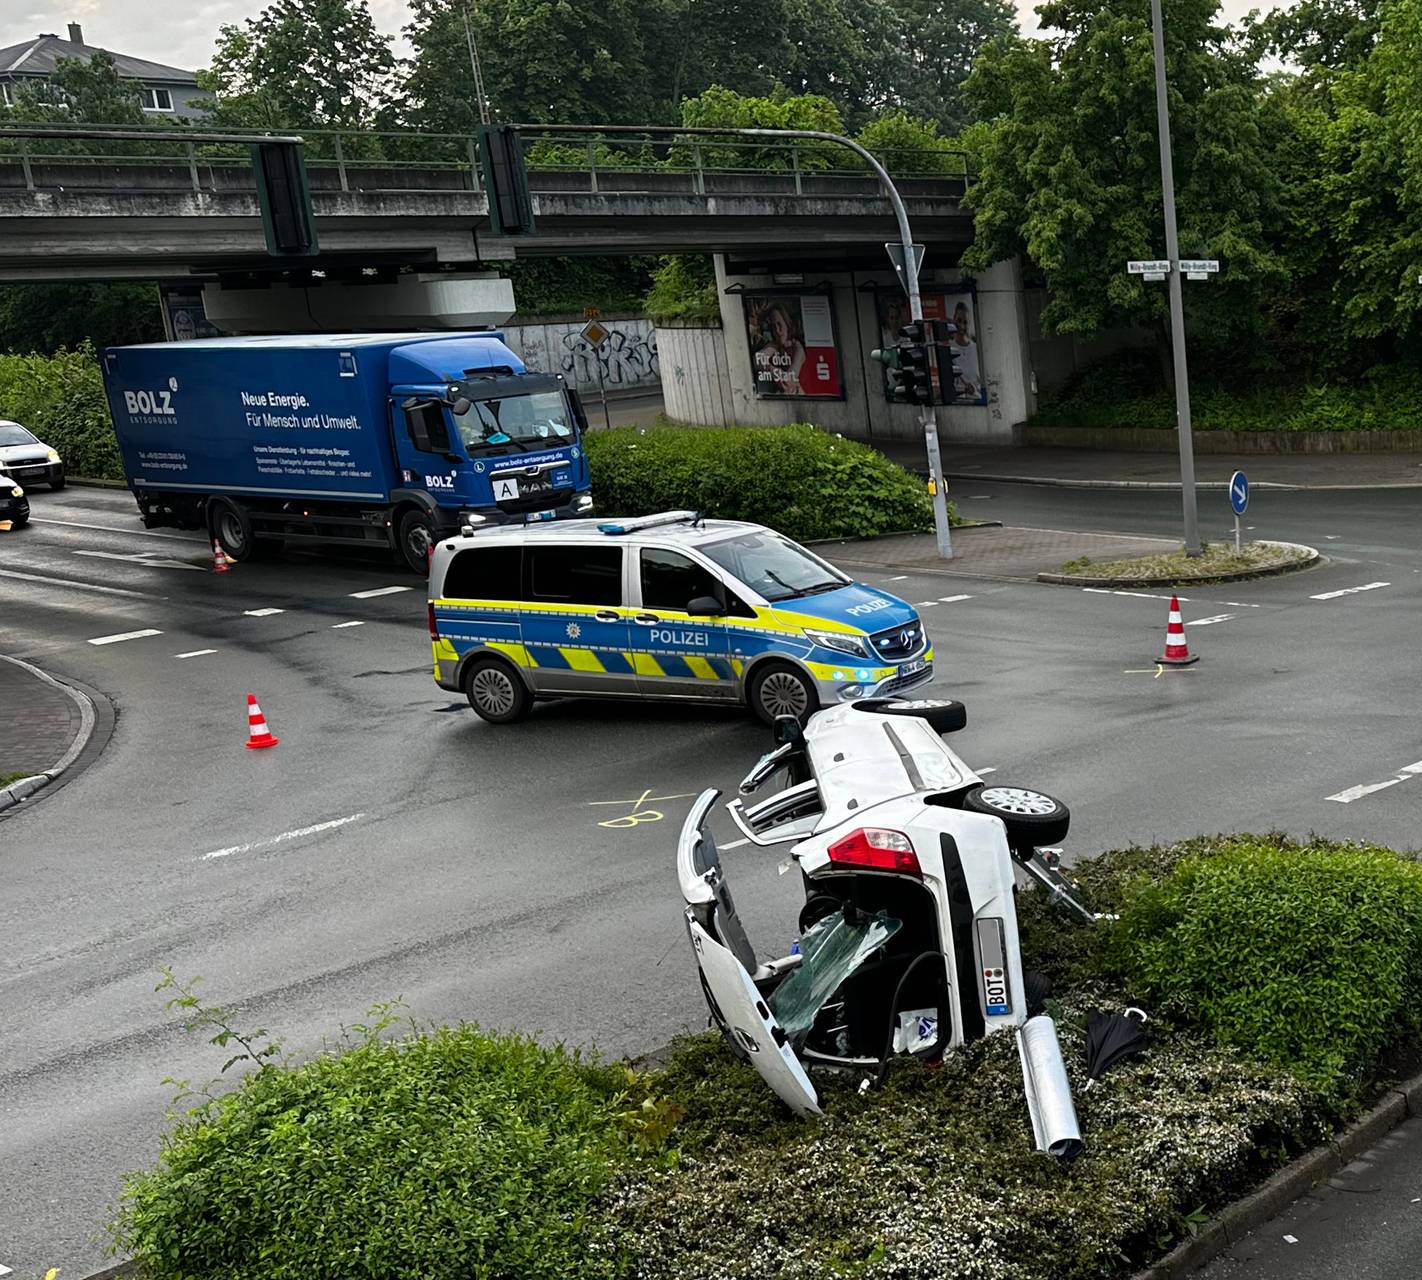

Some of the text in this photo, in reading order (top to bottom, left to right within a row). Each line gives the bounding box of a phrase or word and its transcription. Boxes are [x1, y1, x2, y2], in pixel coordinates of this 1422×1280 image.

[755, 352, 792, 366] Für dich
[758, 371, 772, 382] am
[124, 391, 175, 414] BOLZ
[241, 391, 310, 410] Neue Energie.
[245, 412, 361, 429] Für Mensch und Umwelt.
[494, 452, 563, 468] www.bolz-entsorgung.de
[425, 475, 454, 488] BOLZ
[501, 482, 513, 498] A
[845, 598, 895, 616] POLIZEI
[650, 629, 709, 647] POLIZEI
[986, 978, 1005, 1005] BOT
